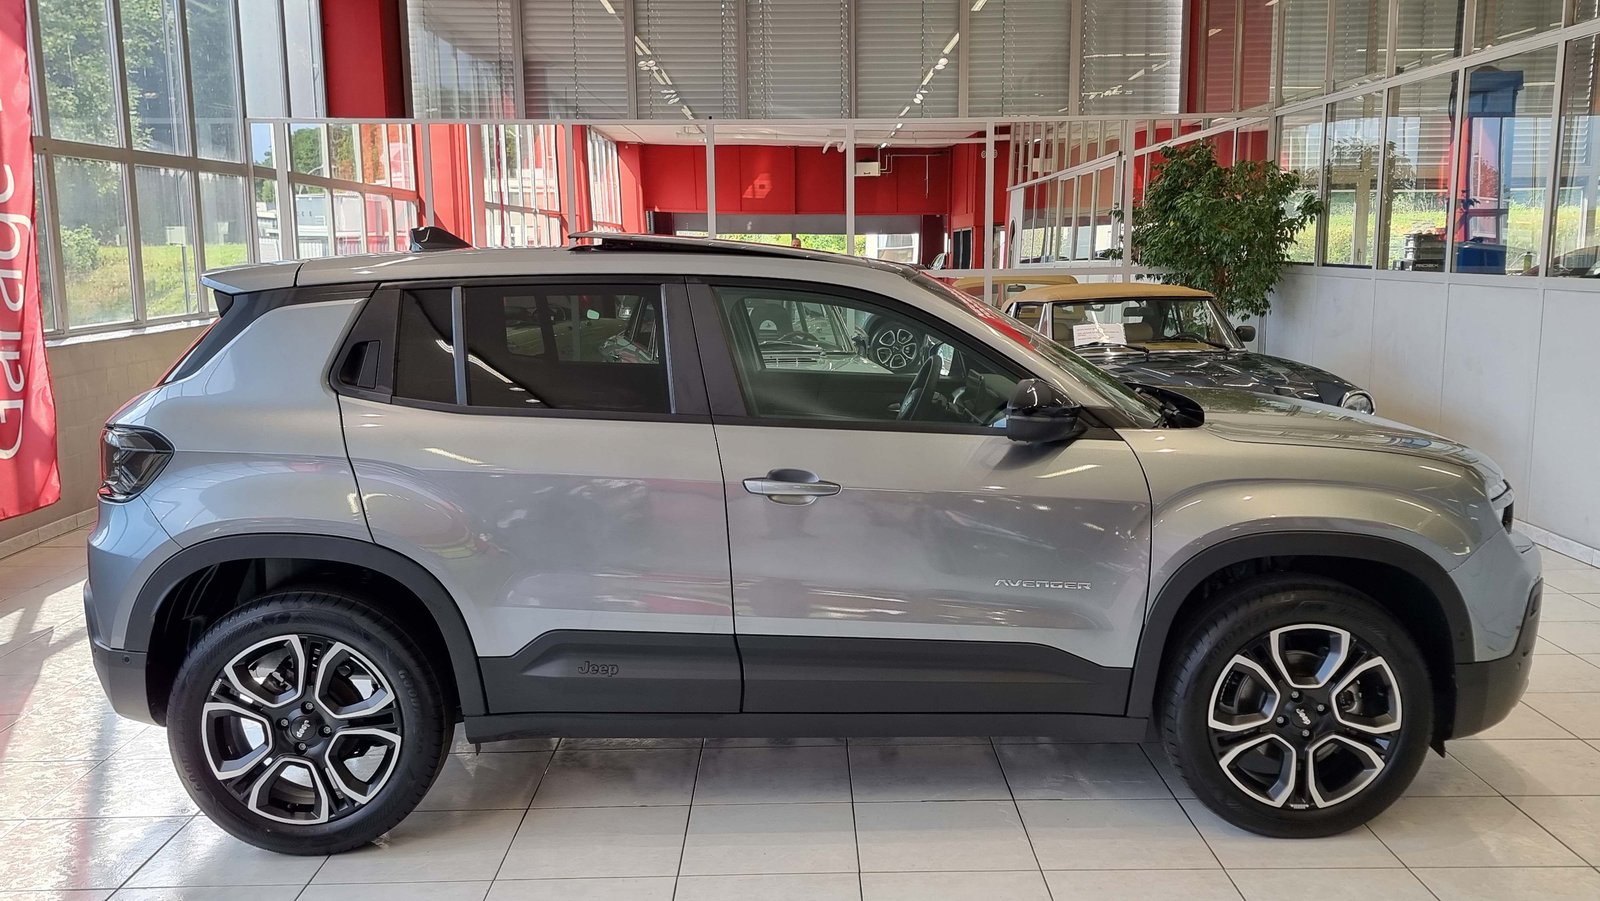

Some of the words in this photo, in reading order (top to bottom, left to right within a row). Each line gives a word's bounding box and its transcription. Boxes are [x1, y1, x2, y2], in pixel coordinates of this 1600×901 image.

[994, 579, 1092, 591] AVENGER
[577, 660, 619, 678] Jeep
[1295, 708, 1311, 725] Jeep
[296, 719, 311, 738] Jeep
